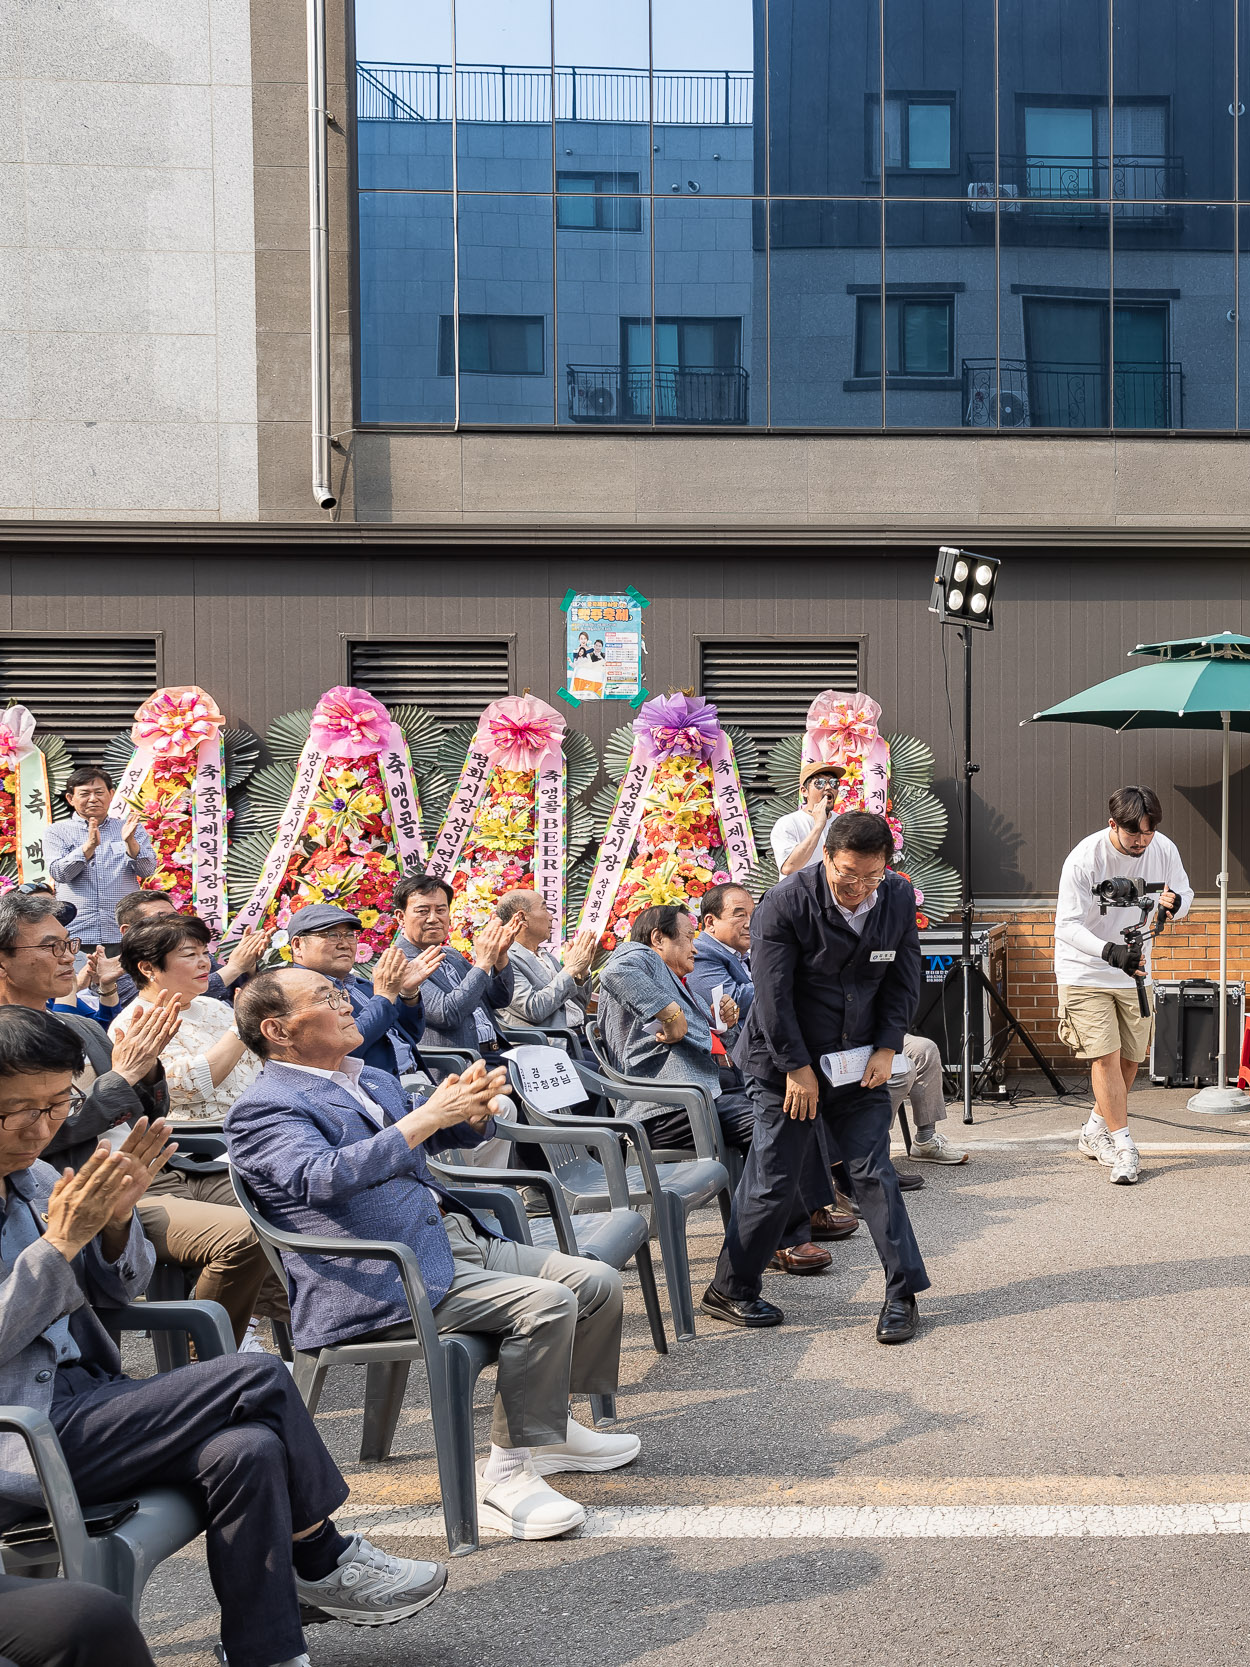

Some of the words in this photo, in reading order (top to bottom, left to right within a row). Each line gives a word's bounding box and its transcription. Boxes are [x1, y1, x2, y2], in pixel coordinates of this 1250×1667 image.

[198, 763, 220, 780] 축
[386, 752, 405, 779] 축
[541, 769, 562, 784] 축
[714, 759, 733, 776] 축
[870, 763, 886, 779] 축
[454, 752, 489, 814] 평화시장
[24, 788, 46, 819] 축
[391, 784, 416, 839] 앵콜
[541, 788, 562, 814] 앵콜
[600, 764, 648, 872] 신성전통시장
